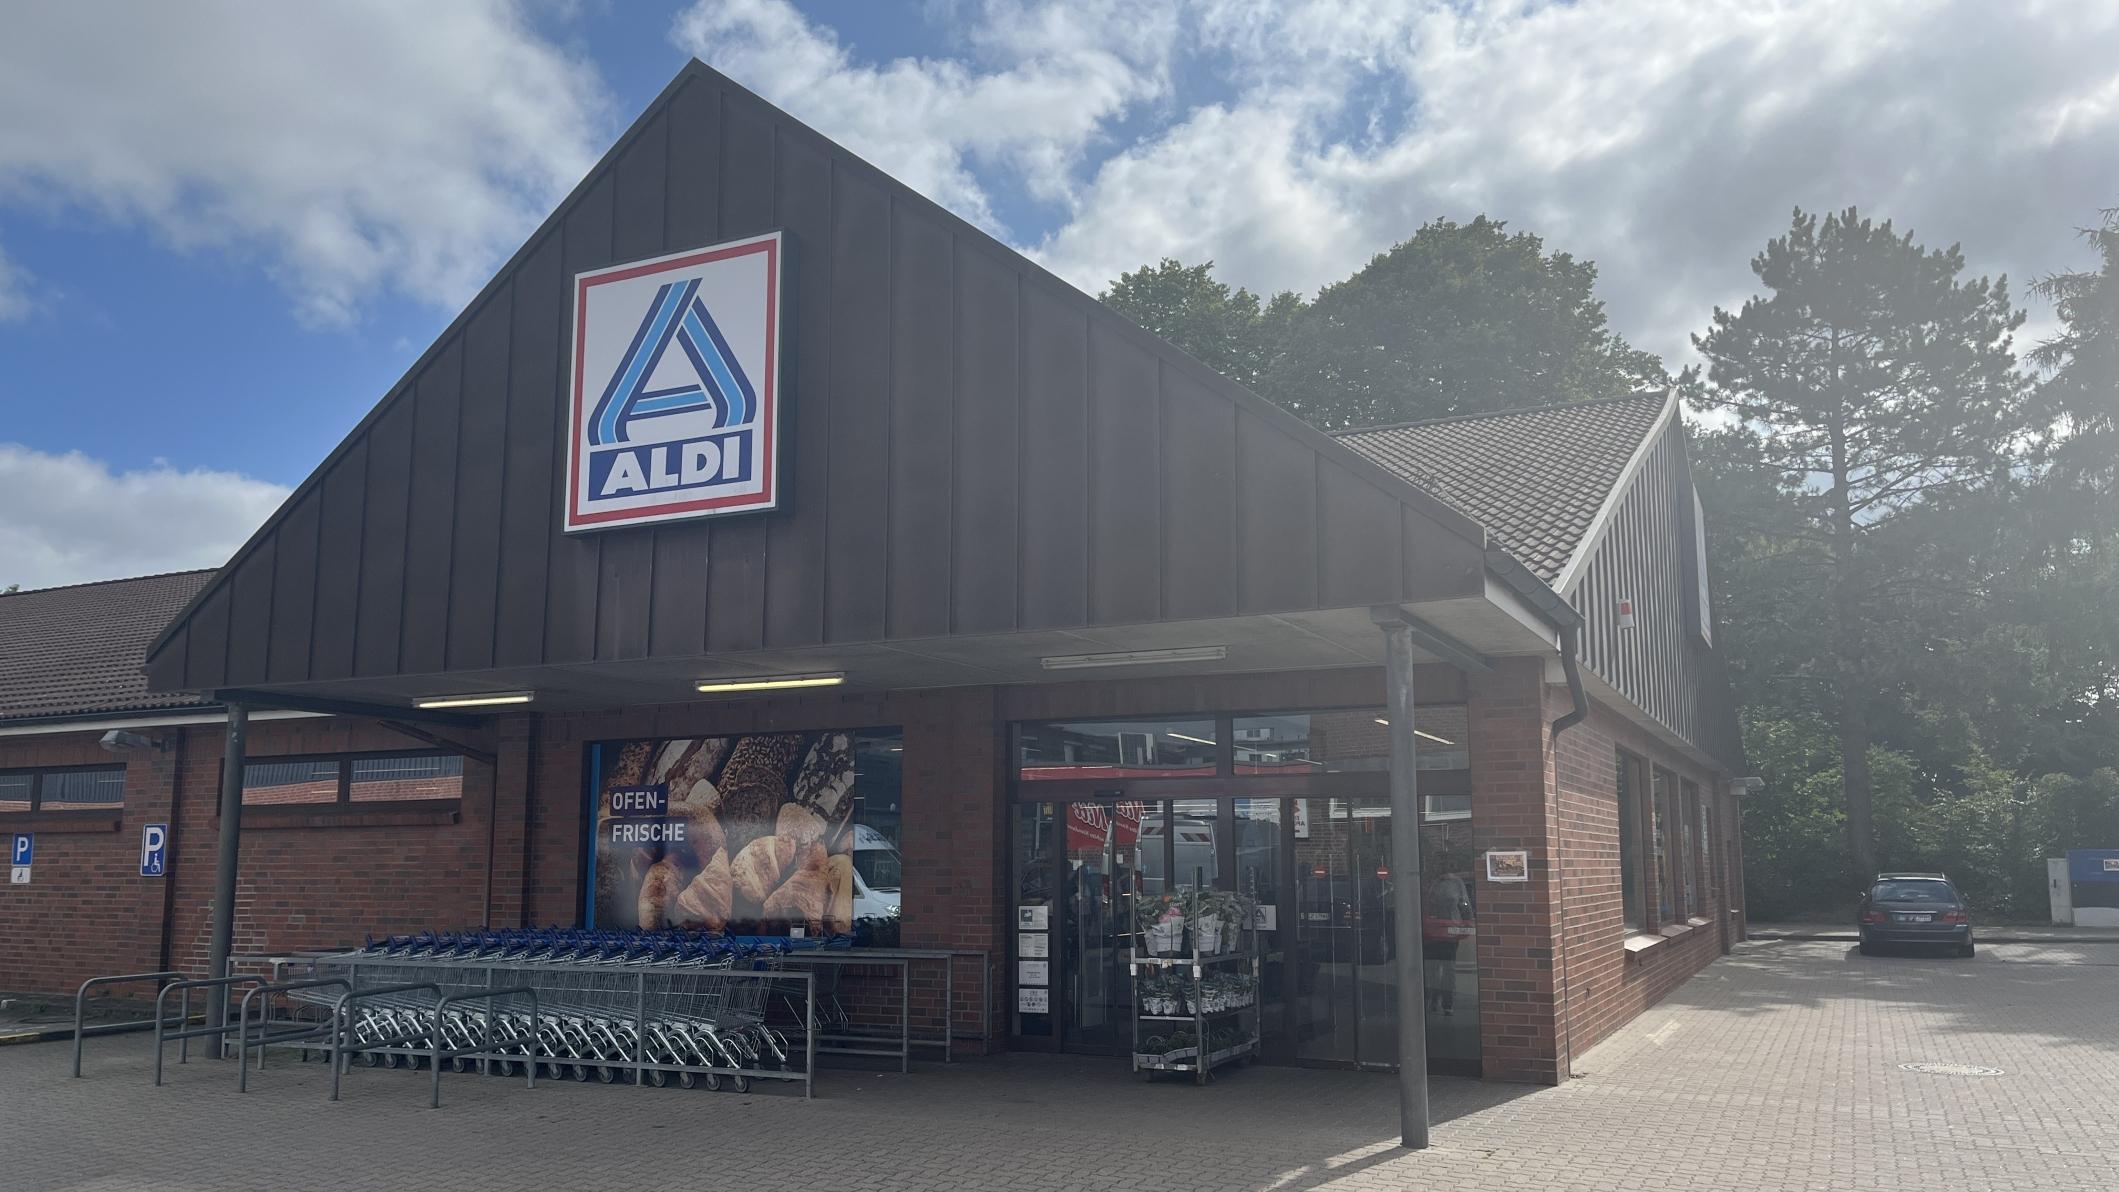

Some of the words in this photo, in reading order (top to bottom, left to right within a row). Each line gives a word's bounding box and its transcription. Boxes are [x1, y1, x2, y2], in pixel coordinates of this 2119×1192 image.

[599, 435, 741, 497] ALDI
[612, 791, 666, 810] OFEN-
[612, 823, 685, 842] FRISCHE
[16, 836, 29, 862] P
[143, 826, 165, 867] P
